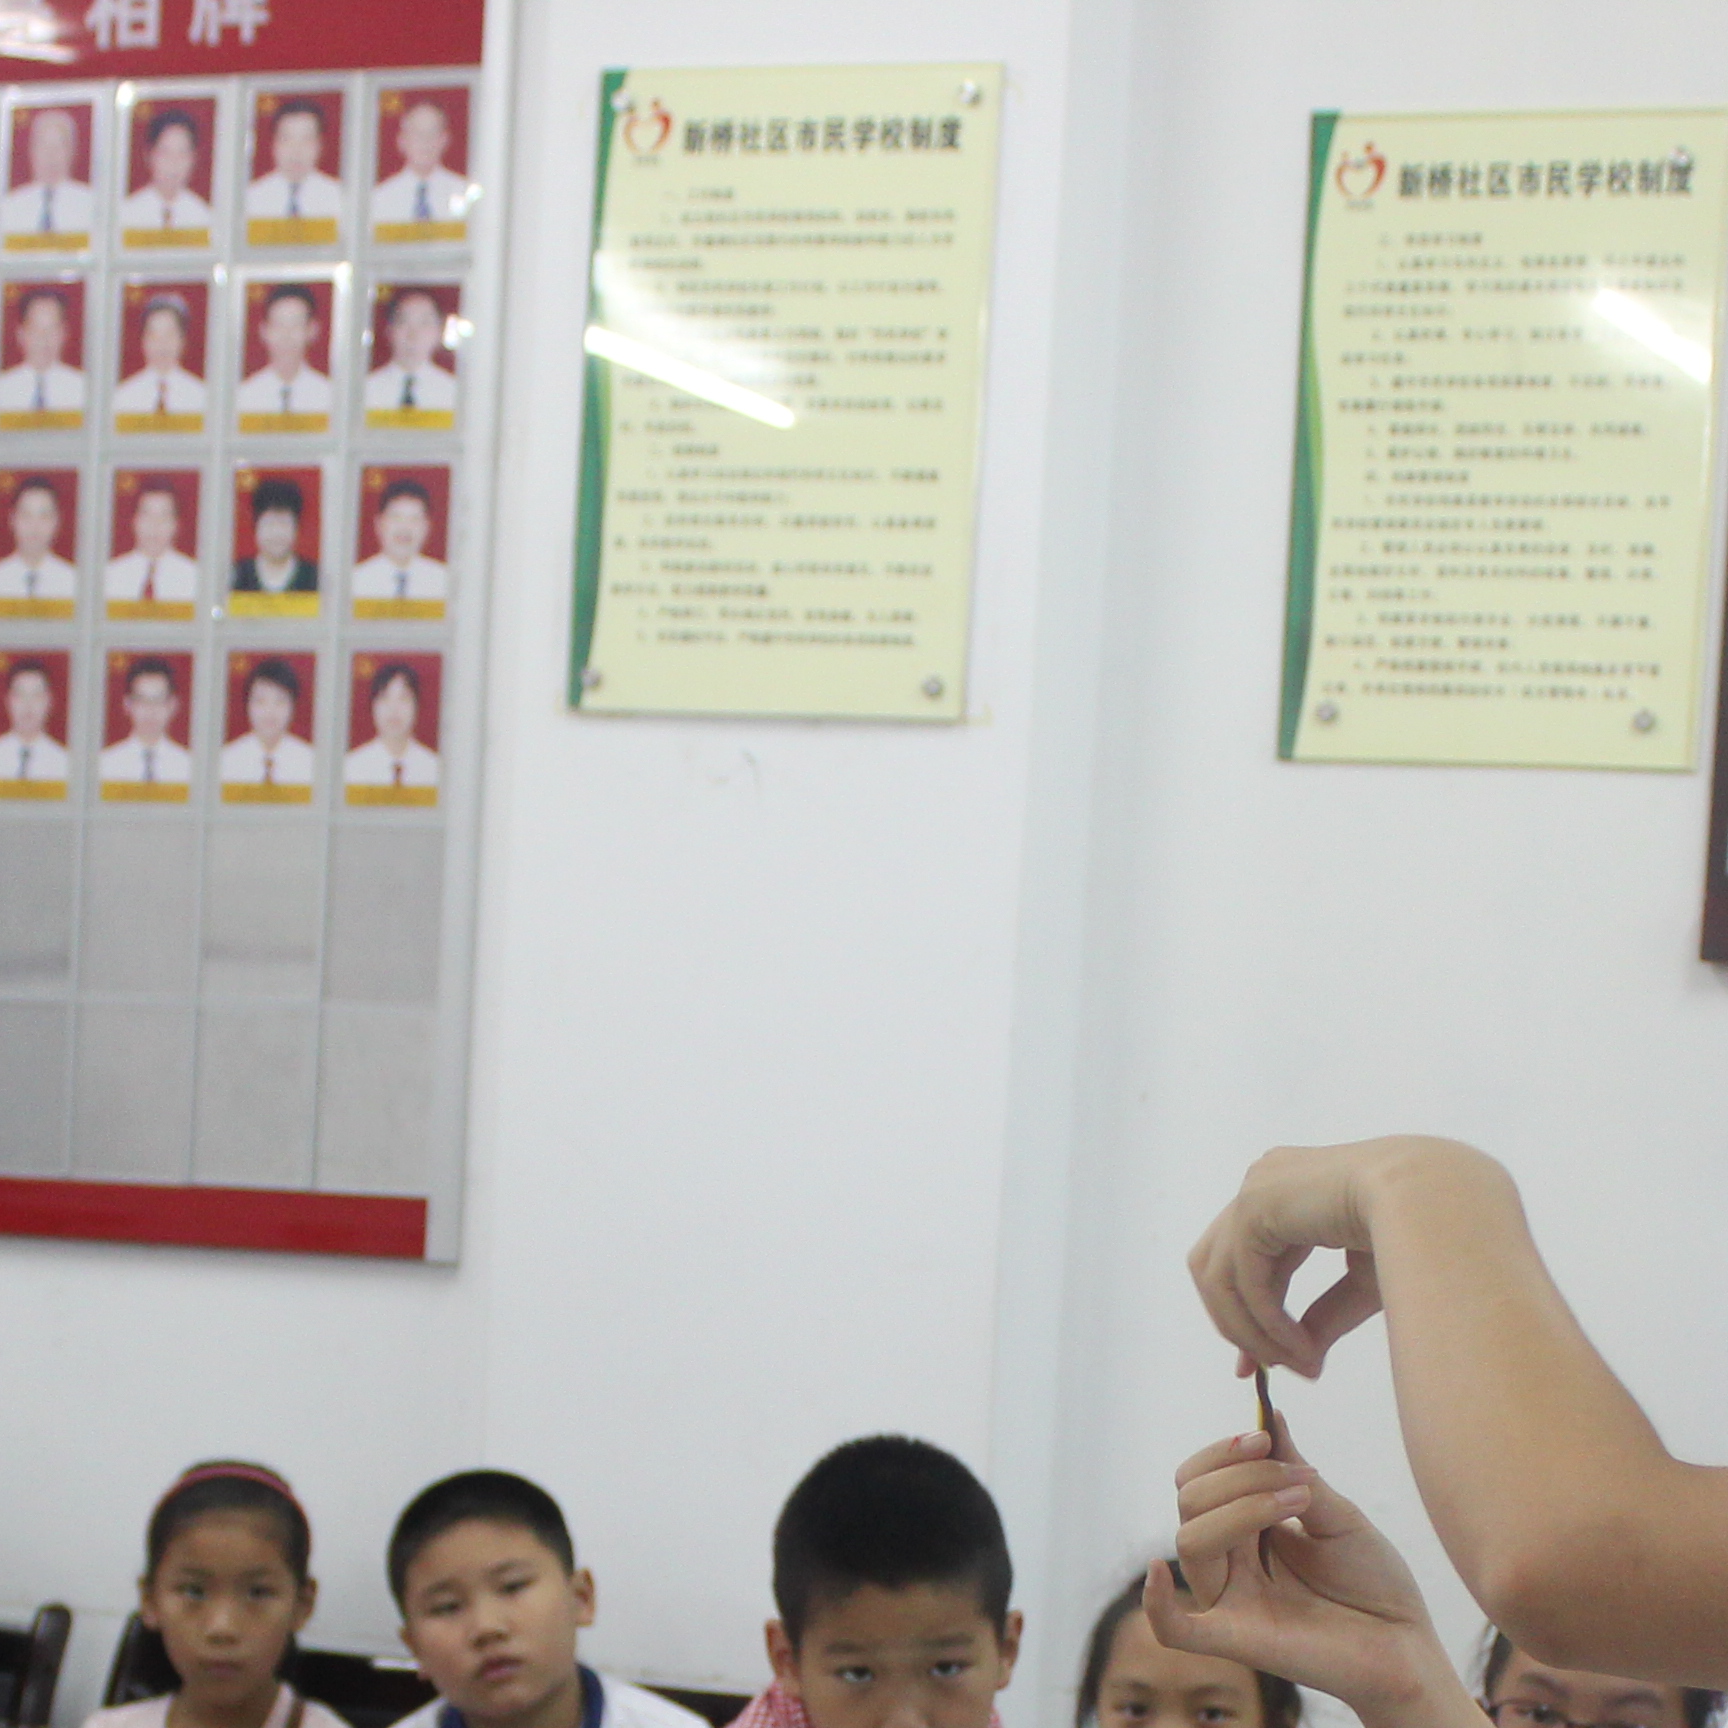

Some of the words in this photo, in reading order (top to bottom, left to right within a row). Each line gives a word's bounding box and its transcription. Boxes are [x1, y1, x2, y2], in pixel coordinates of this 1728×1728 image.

[683, 116, 962, 153] 新桥社区市民学校制度
[1398, 160, 1693, 197] 新桥社区市民学校制度
